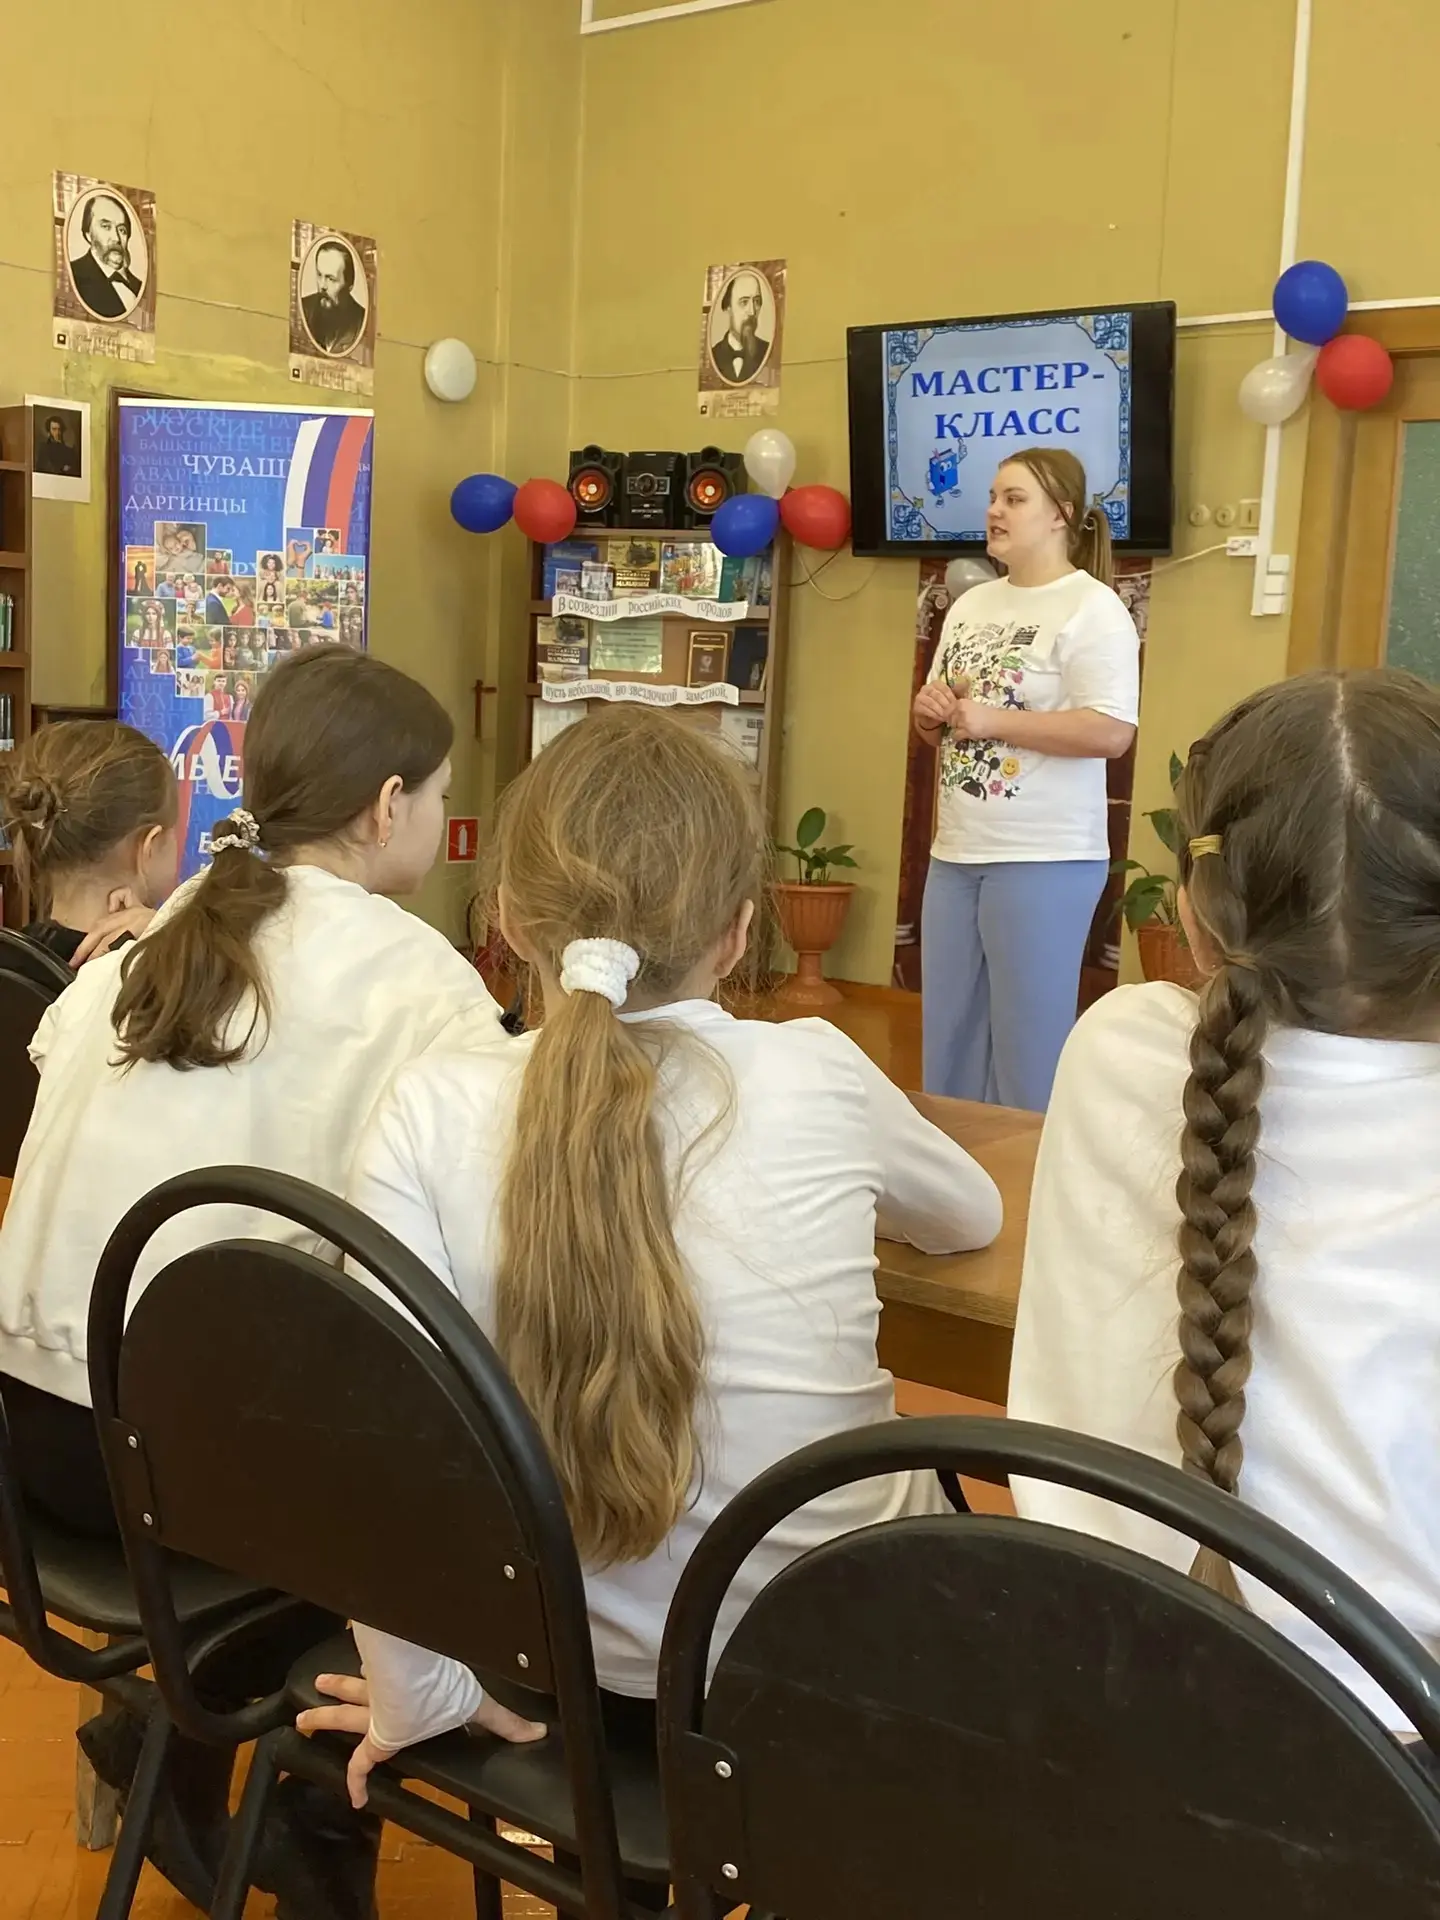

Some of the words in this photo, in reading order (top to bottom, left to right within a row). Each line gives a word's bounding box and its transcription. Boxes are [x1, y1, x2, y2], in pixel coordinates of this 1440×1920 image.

[911, 361, 1105, 398] МАСТЕР-
[131, 414, 265, 438] РУССКИЕ
[934, 407, 1080, 440] КЛАСС
[182, 453, 293, 479] ЧУВАШ
[124, 495, 247, 517] ДАРГИНЦЫ
[558, 596, 566, 613] В
[628, 595, 682, 616] российских
[697, 600, 733, 619] городов
[545, 686, 567, 700] пусть
[615, 684, 627, 697] но
